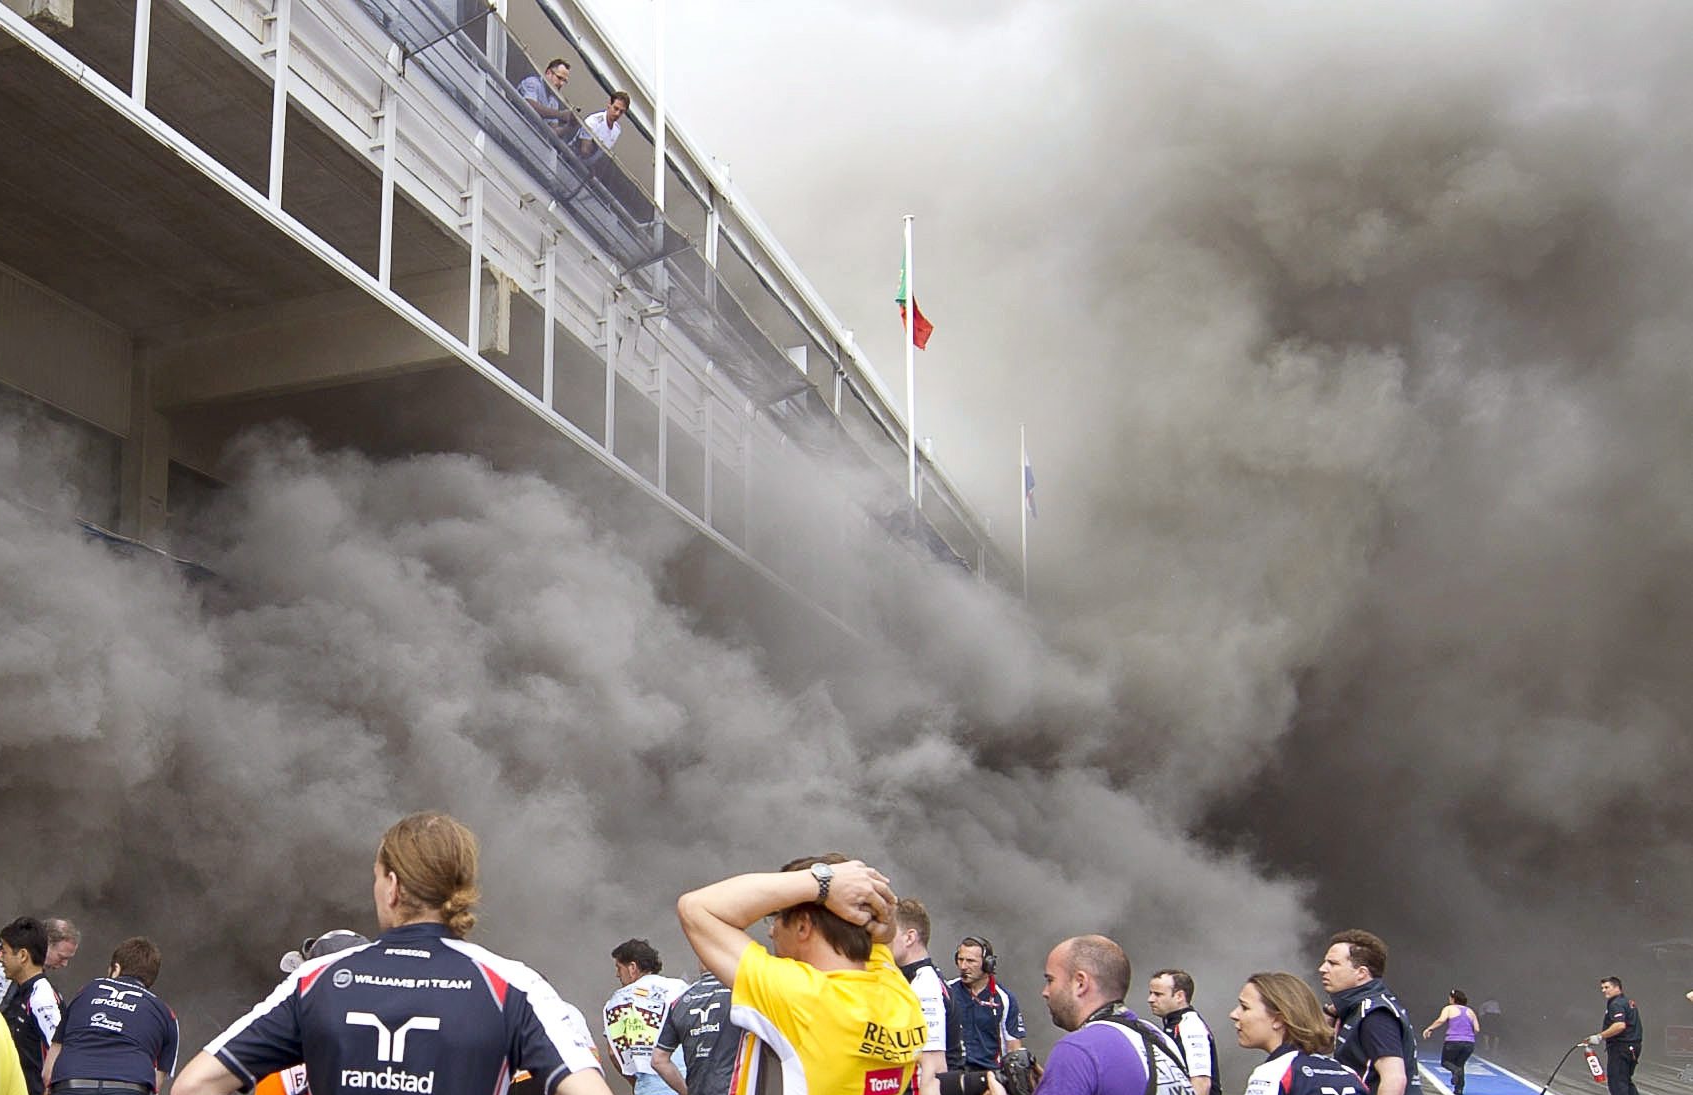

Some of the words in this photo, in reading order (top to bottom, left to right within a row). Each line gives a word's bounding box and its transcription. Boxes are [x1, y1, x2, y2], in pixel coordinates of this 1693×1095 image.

[354, 974, 416, 988] WILLIAMS
[430, 979, 472, 990] TEAM
[341, 1066, 434, 1094] randstad
[869, 1077, 899, 1092] TOTAL
